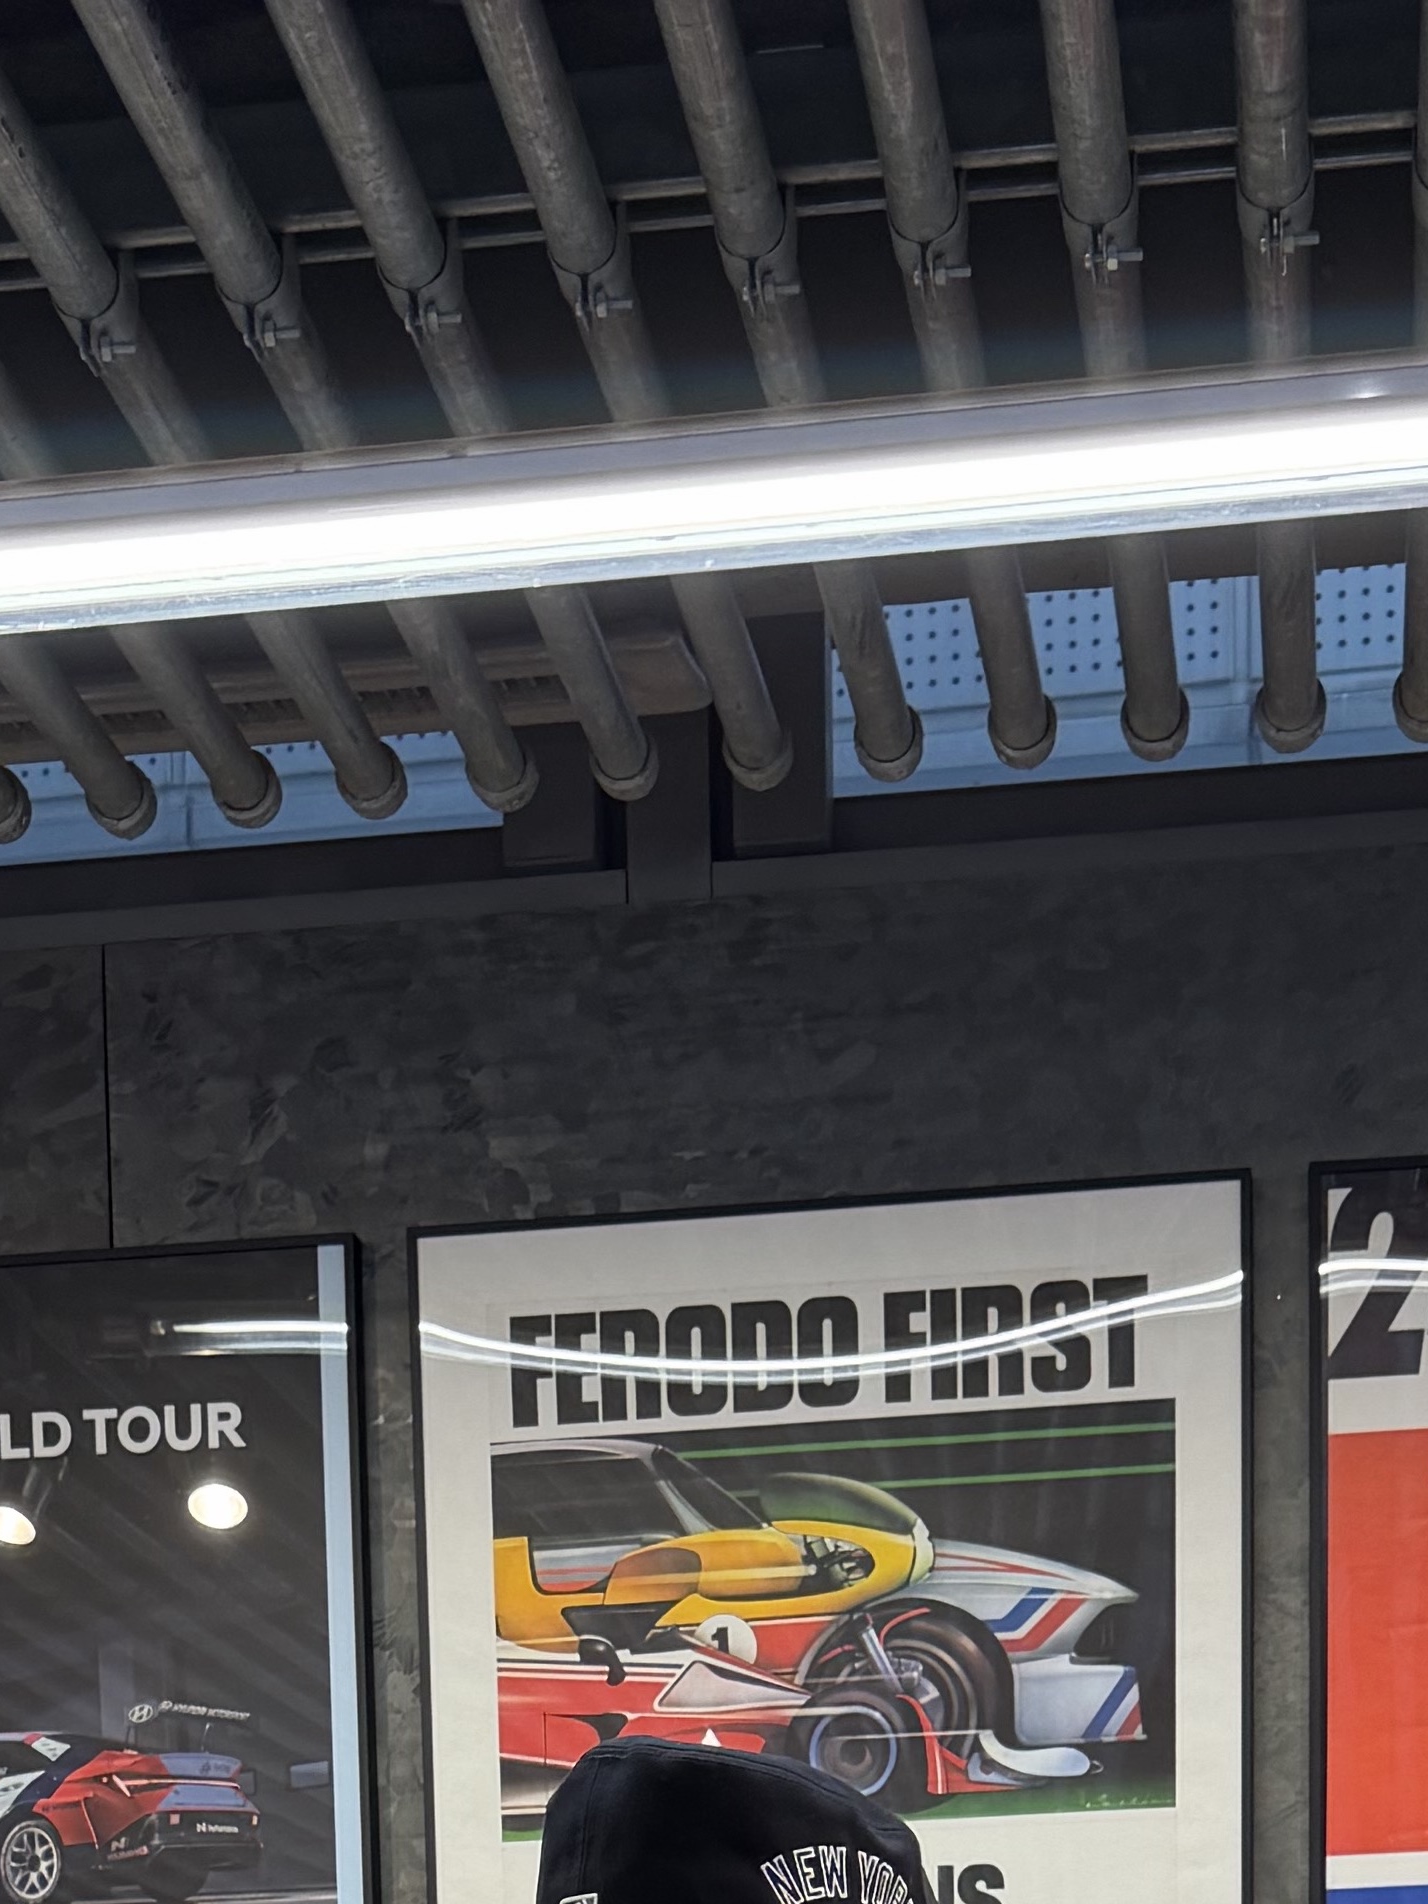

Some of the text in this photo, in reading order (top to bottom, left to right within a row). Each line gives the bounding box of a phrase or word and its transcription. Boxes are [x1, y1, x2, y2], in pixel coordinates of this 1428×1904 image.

[509, 1274, 1149, 1428] FERODO FIRST
[82, 1402, 247, 1456] TOUR
